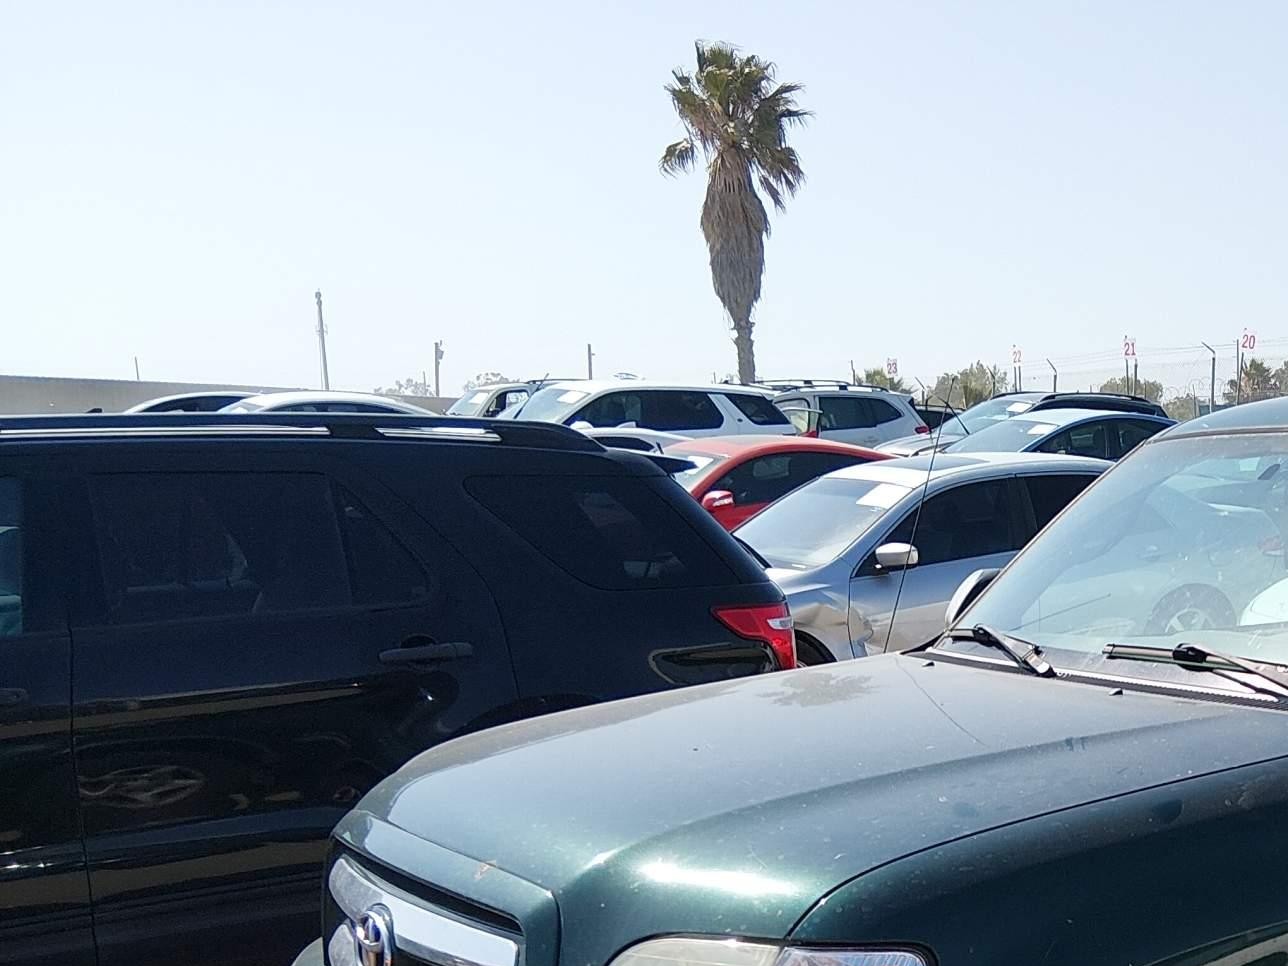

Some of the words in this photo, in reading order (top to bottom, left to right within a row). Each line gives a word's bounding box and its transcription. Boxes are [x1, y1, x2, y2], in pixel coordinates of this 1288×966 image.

[1124, 342, 1136, 356] 21
[1241, 334, 1256, 350] 20
[886, 362, 898, 375] 23
